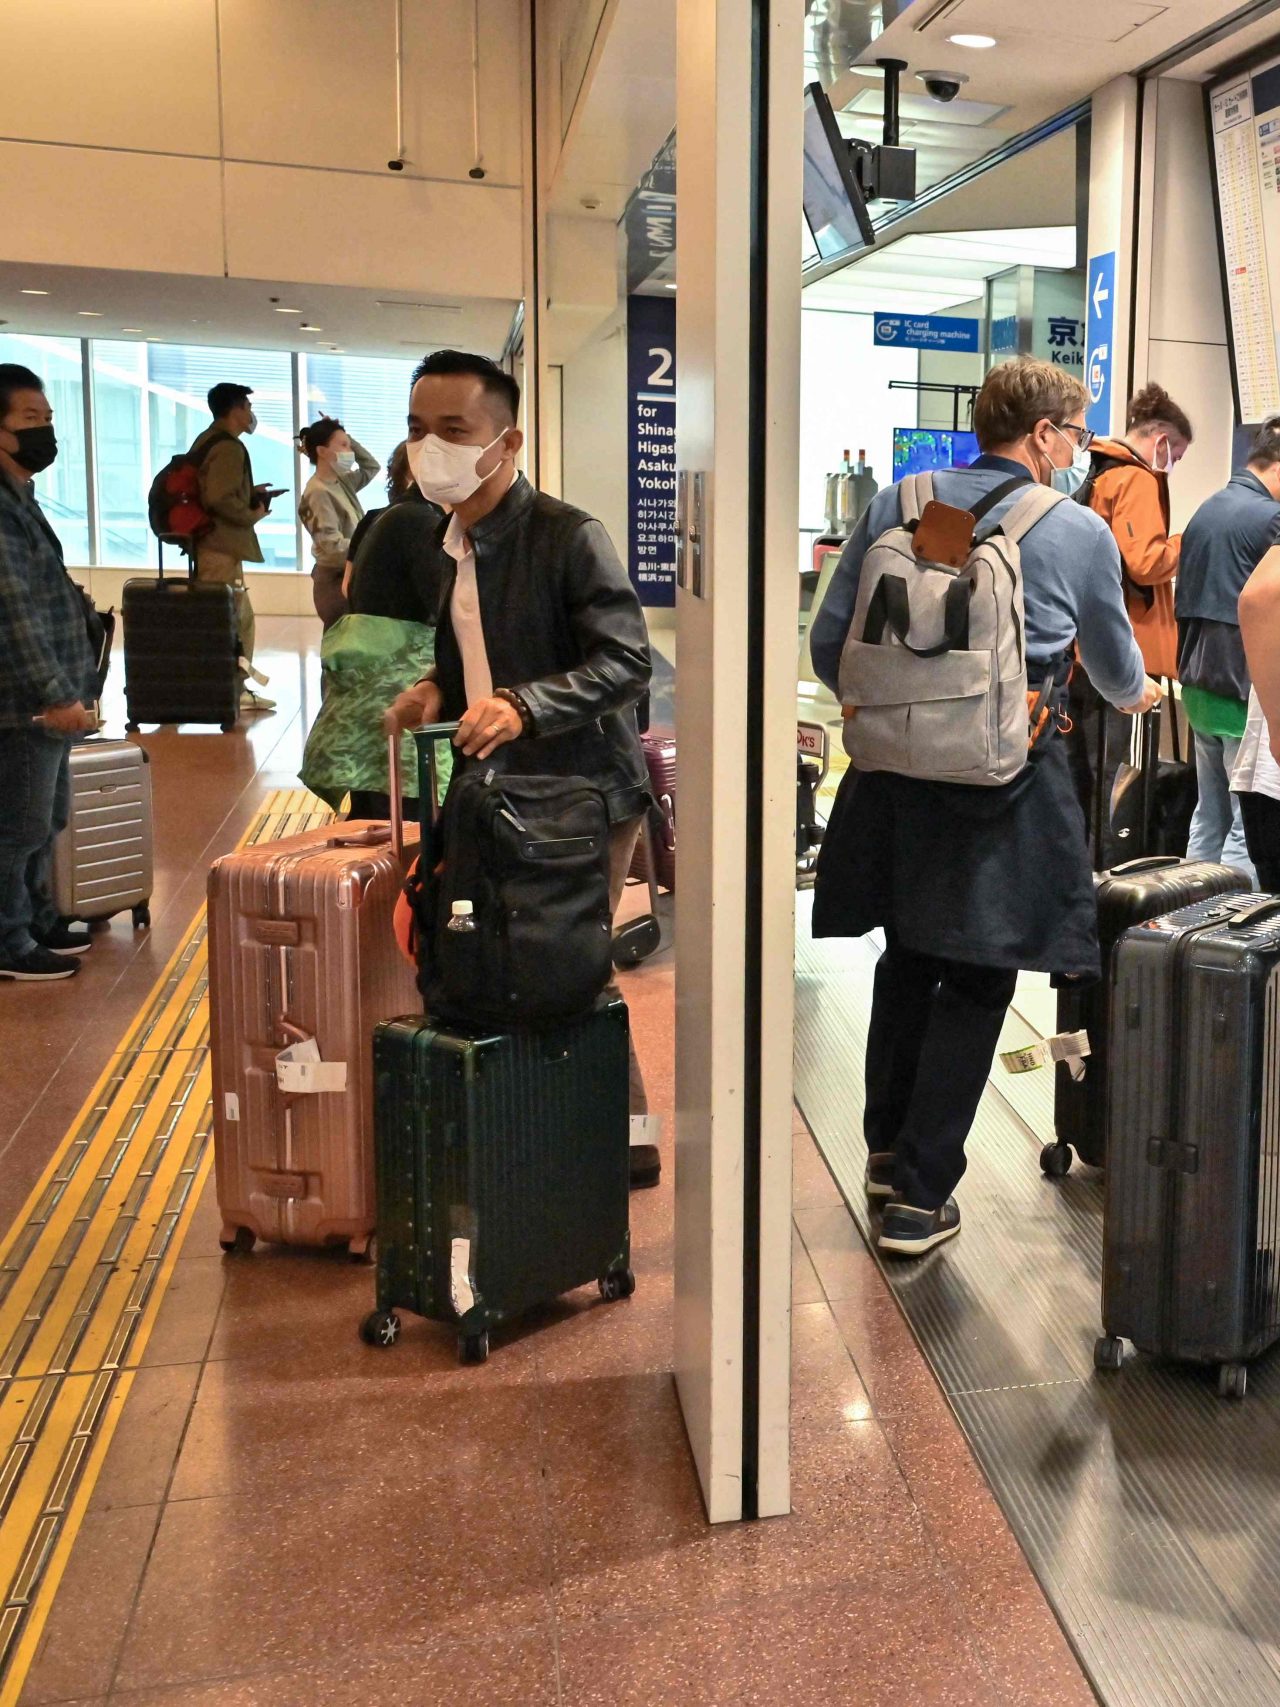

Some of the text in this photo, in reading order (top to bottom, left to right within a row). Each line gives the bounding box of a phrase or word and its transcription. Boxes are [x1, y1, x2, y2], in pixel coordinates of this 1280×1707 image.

[913, 320, 930, 329] card
[906, 328, 970, 340] charging machine
[1048, 316, 1085, 347] 京
[647, 348, 674, 386] 2
[637, 404, 657, 417] for
